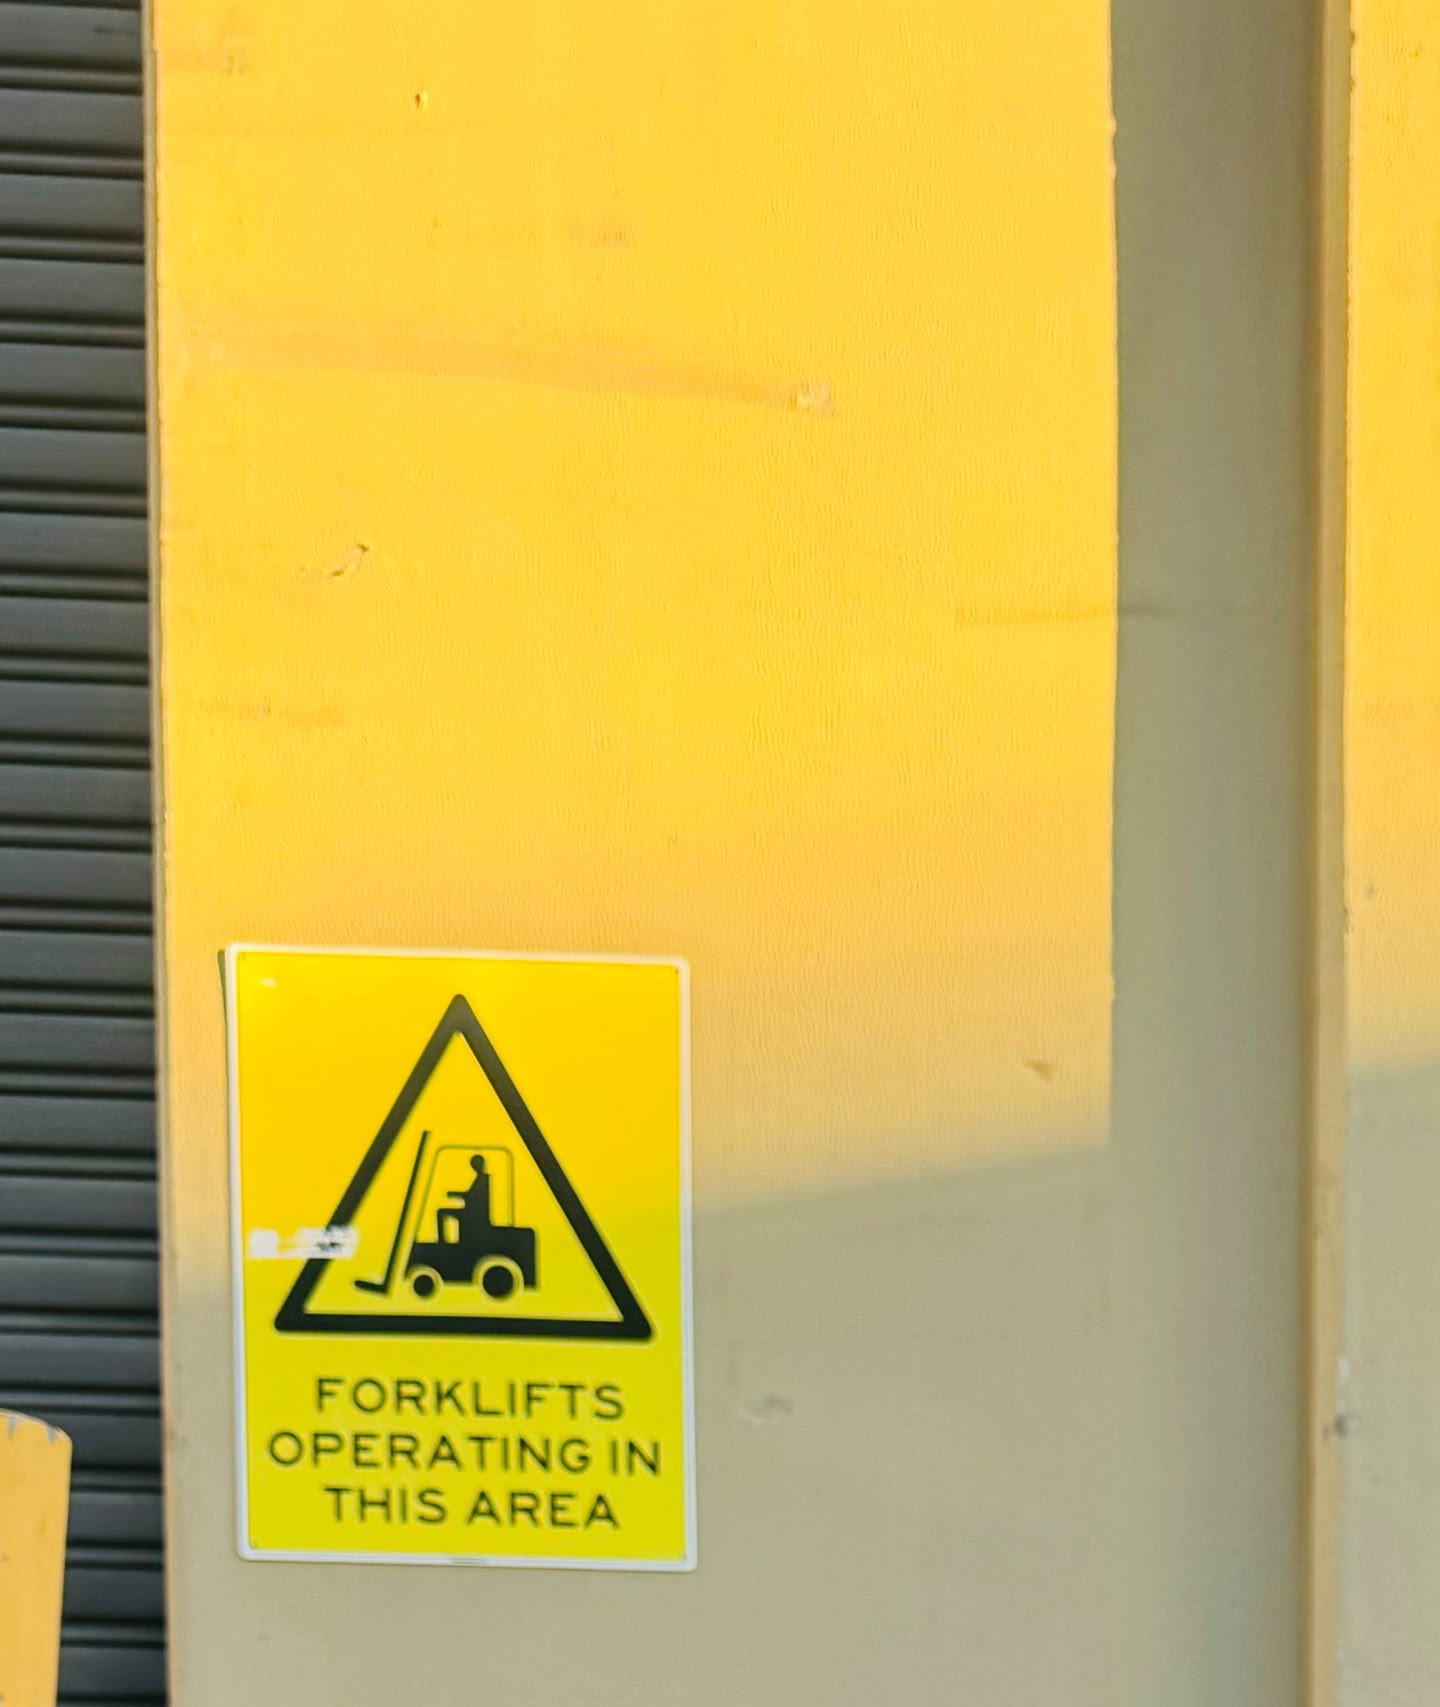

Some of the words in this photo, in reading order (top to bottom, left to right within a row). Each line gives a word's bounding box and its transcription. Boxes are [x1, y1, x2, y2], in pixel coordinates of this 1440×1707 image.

[315, 1377, 625, 1421] FORKLIFTS
[268, 1431, 592, 1473] OPERATING
[609, 1441, 661, 1477] IN
[324, 1486, 448, 1525] THIS
[466, 1492, 621, 1529] AREA
